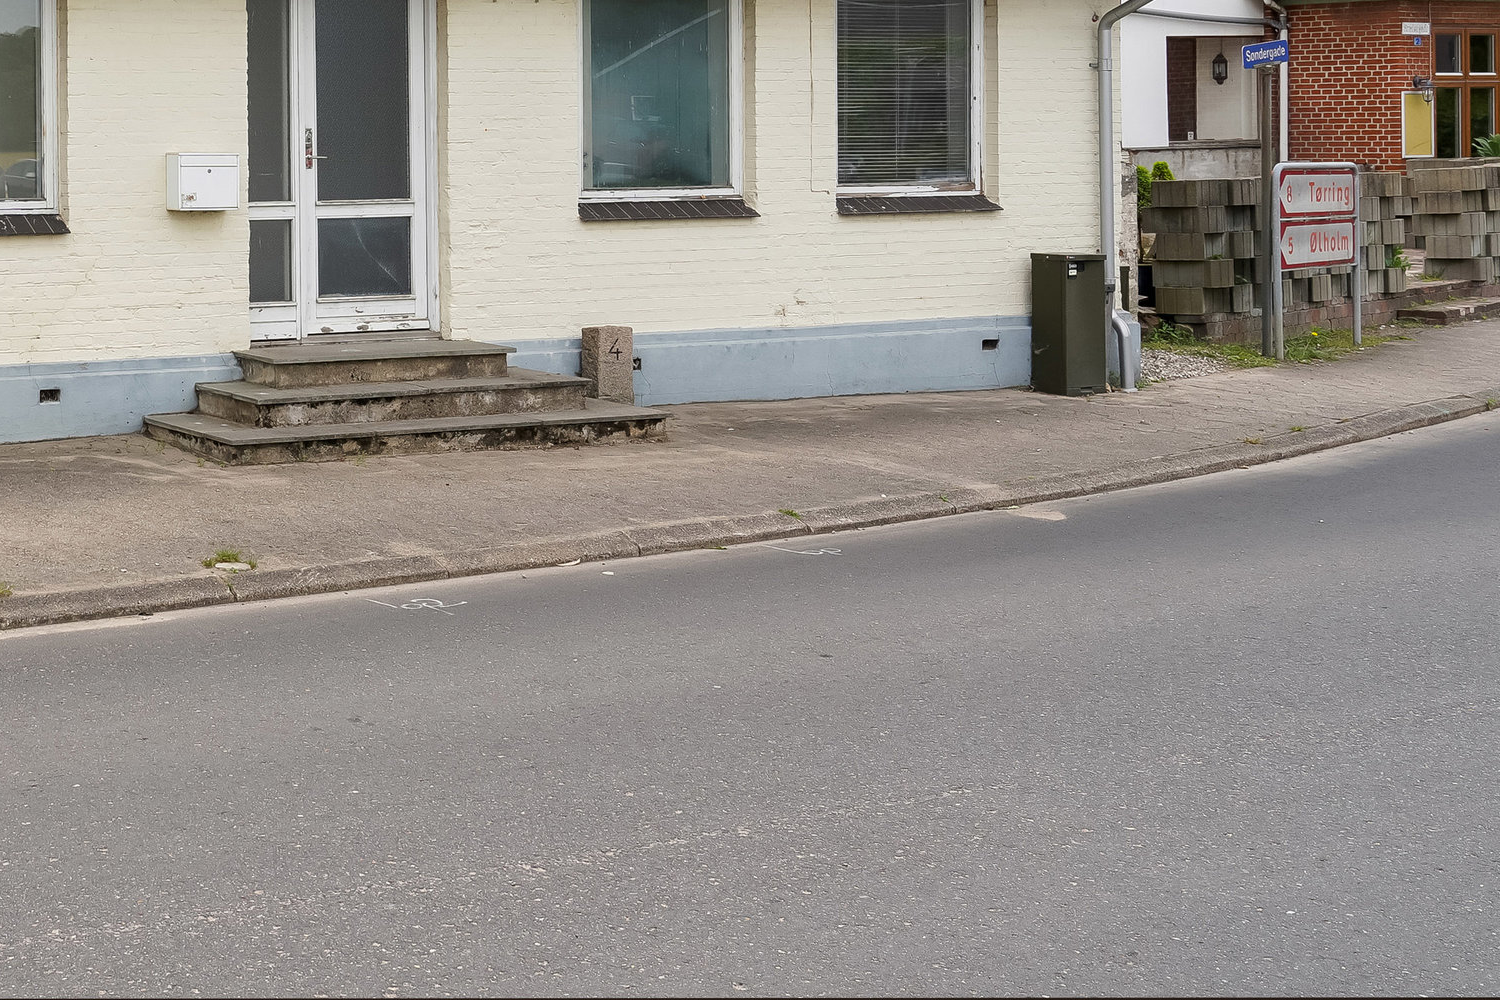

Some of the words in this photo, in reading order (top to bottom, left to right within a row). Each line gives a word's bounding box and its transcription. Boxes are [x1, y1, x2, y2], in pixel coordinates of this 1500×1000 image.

[1286, 184, 1292, 203] 8
[1309, 182, 1350, 206] Tørring
[1288, 237, 1294, 255] 5
[1310, 231, 1349, 253] Ølholm
[608, 338, 623, 361] 4
